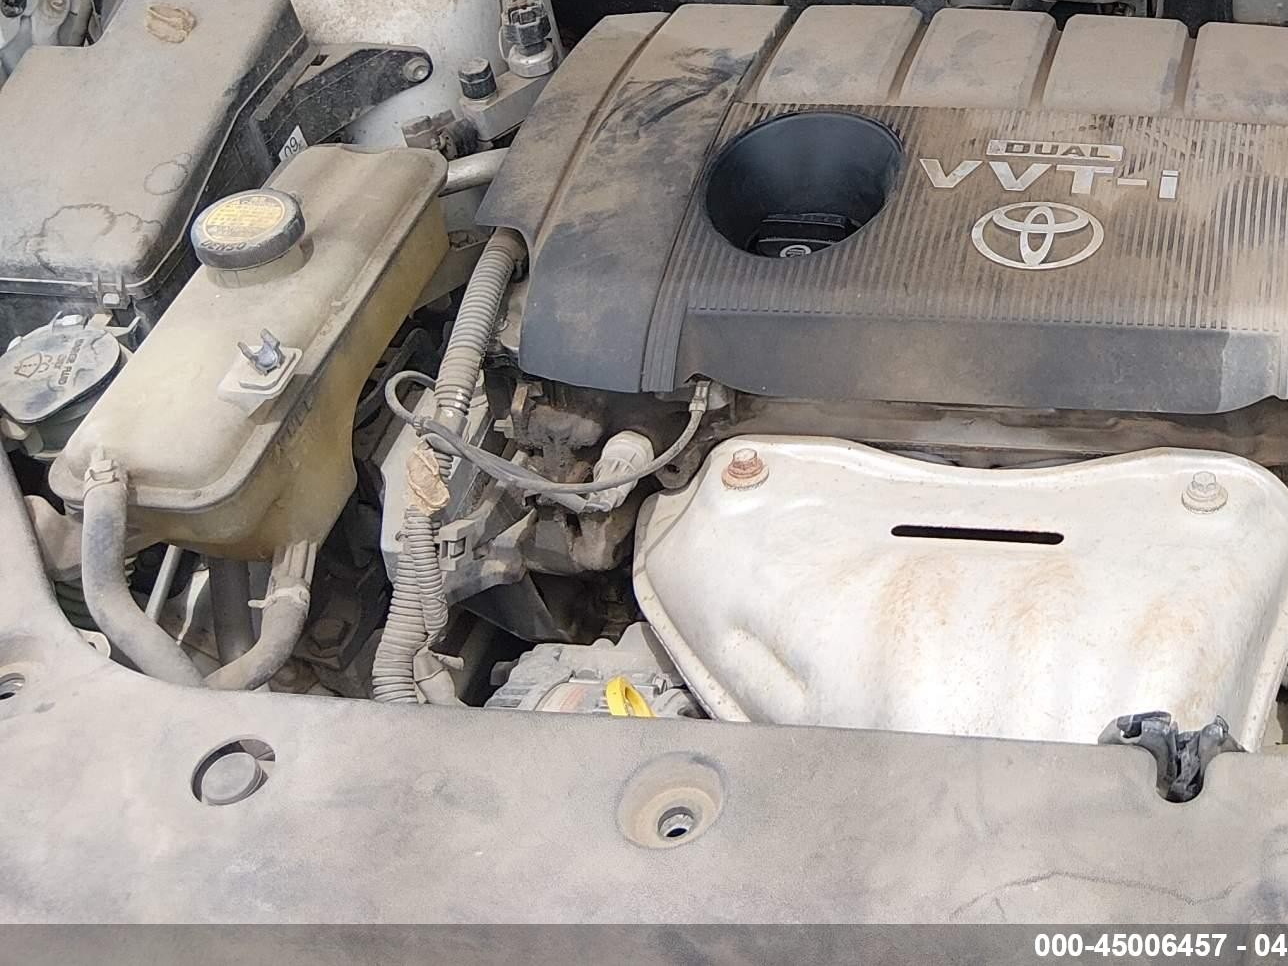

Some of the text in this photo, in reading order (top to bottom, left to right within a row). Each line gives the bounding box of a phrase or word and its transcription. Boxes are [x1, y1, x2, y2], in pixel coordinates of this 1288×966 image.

[1004, 141, 1110, 159] DUAL
[919, 158, 1181, 200] VVT-i
[201, 240, 247, 252] DENSO
